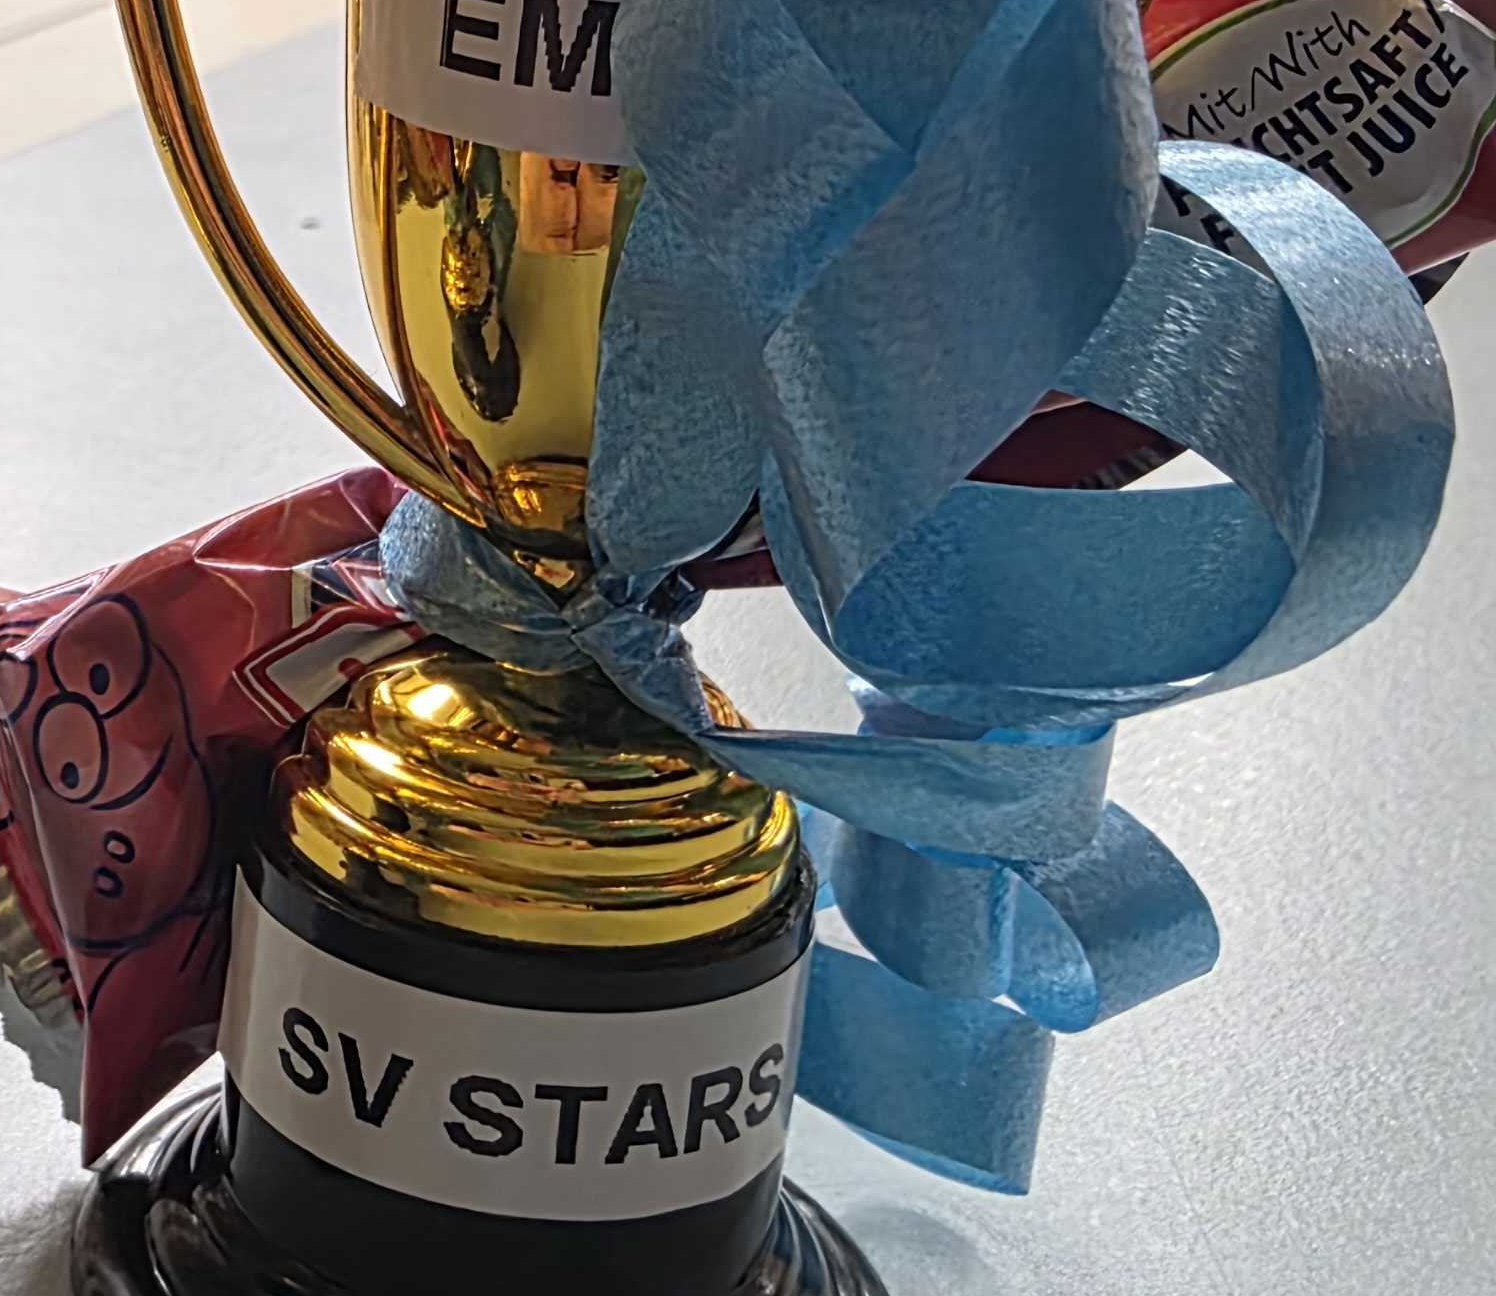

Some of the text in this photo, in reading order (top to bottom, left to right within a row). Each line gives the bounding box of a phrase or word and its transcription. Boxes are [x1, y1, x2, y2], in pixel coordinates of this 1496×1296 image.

[1161, 11, 1371, 139] Mit With
[1346, 42, 1470, 177] JUICE
[278, 1006, 786, 1166] SV STARS
